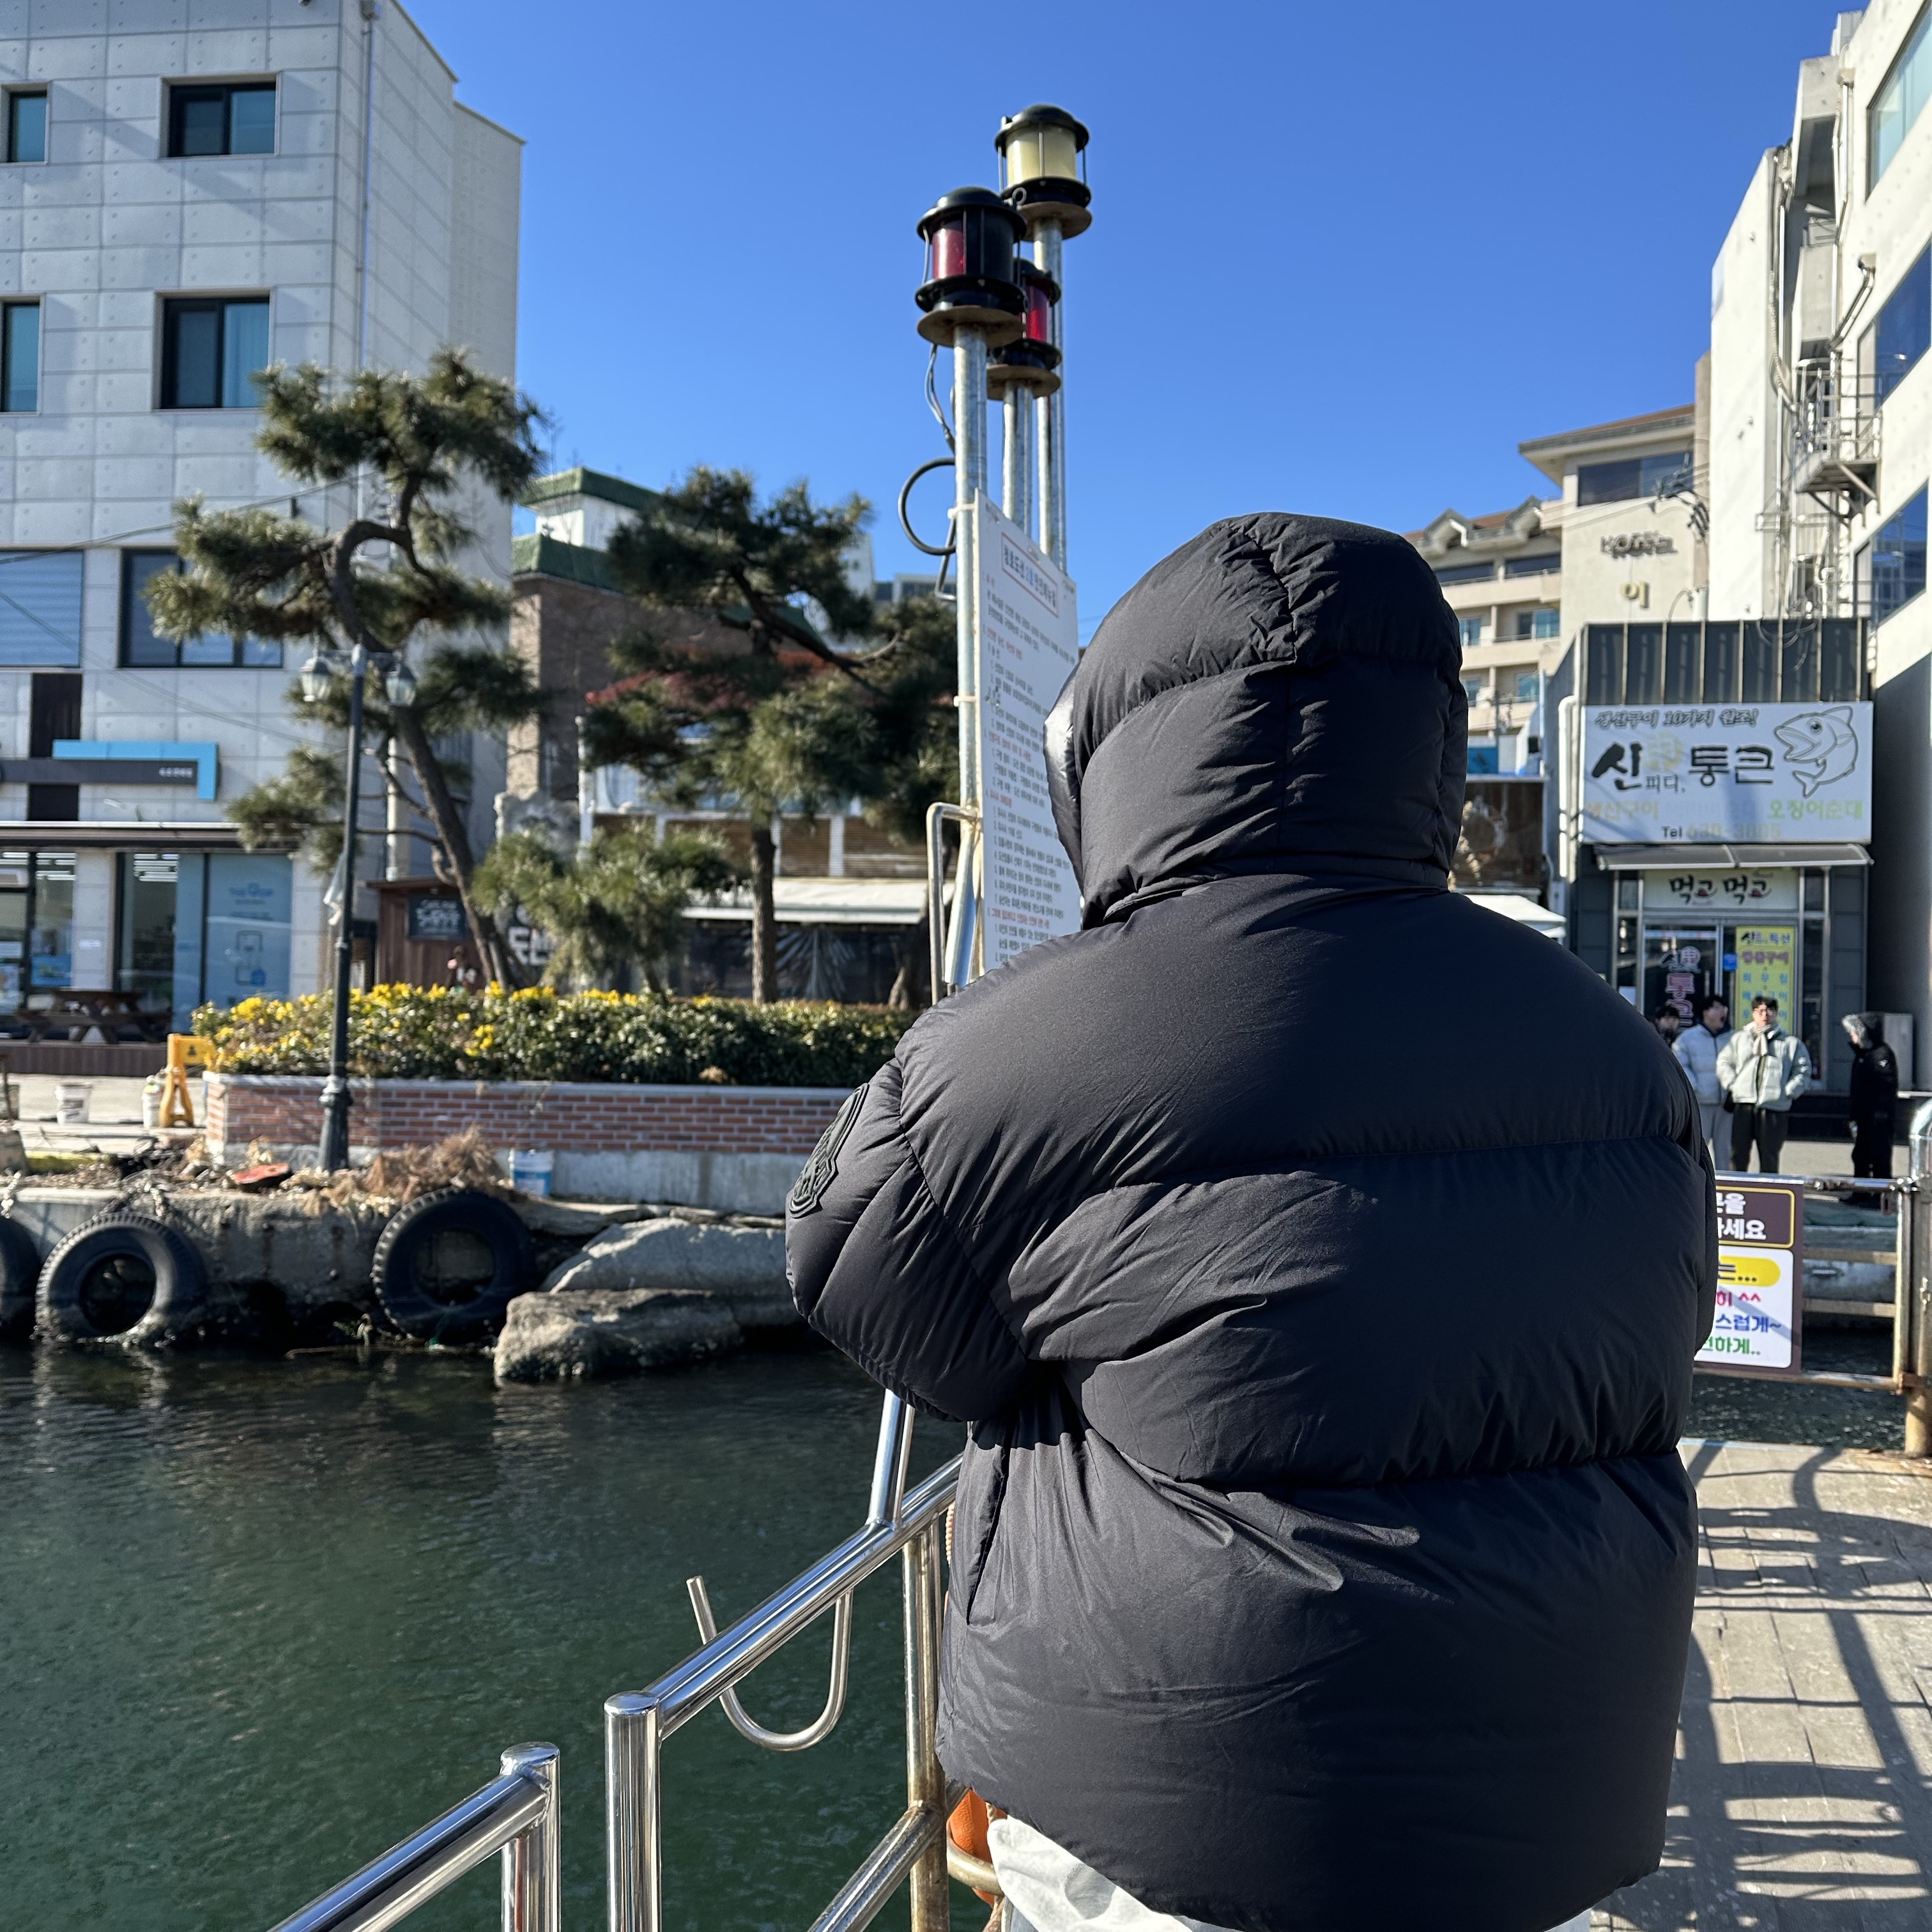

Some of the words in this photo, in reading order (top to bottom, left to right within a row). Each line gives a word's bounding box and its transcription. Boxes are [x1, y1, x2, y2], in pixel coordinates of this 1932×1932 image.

[1595, 709, 1659, 729] 생선구이
[1663, 709, 1715, 728] 10가지
[1718, 707, 1759, 728] 원조!
[1591, 741, 1643, 790] 신
[1689, 745, 1775, 786] 통큰
[1768, 799, 1863, 820] 오징어순대
[1661, 825, 1683, 838] Tel
[1669, 873, 1717, 905] 먹고
[1722, 873, 1772, 905] 먹고
[1715, 1314, 1782, 1333] 스럽게~
